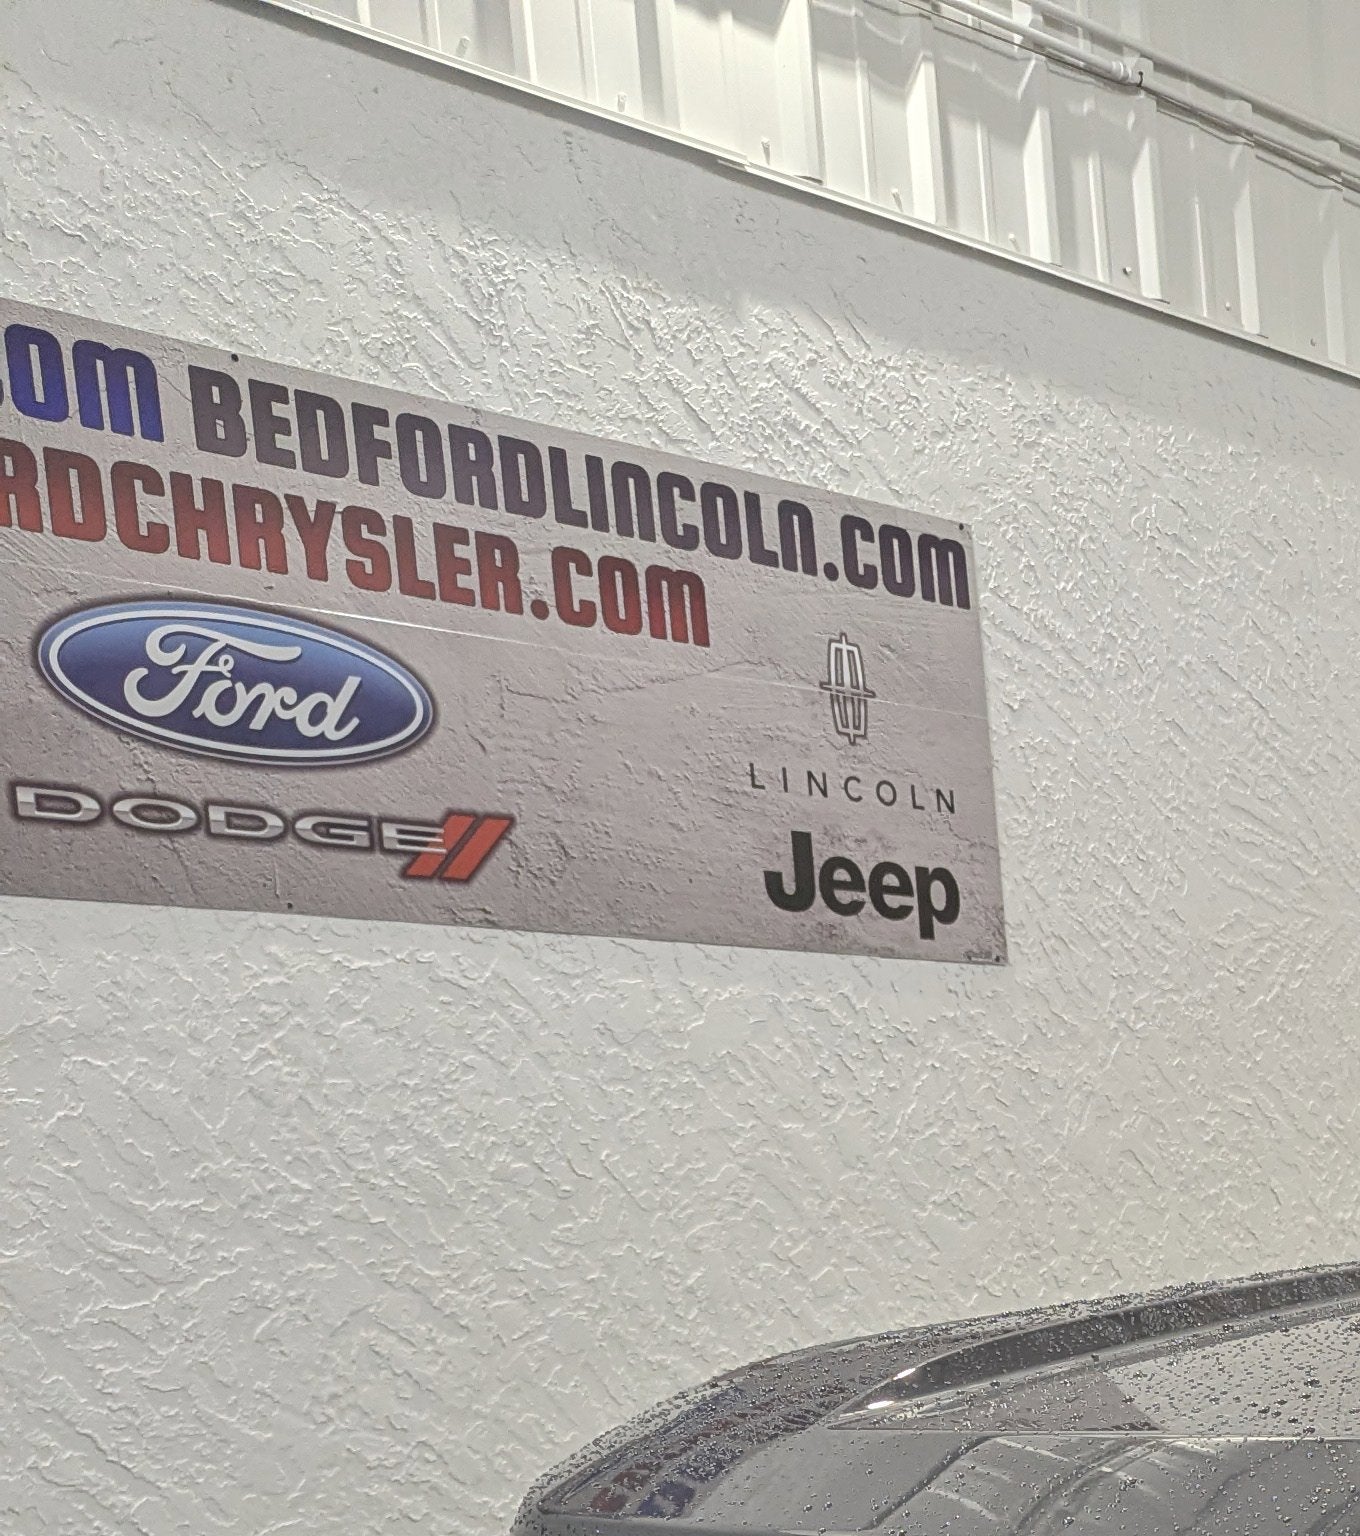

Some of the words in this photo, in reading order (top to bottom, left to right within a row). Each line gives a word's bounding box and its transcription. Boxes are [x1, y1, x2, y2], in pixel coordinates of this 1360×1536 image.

[0, 323, 164, 443] OM
[188, 364, 972, 611] BEDFORDLINCOLN.COM
[123, 623, 362, 742] Ford
[13, 784, 448, 856] DODGE
[748, 762, 957, 815] LINCOLN
[763, 830, 961, 940] Jeep
